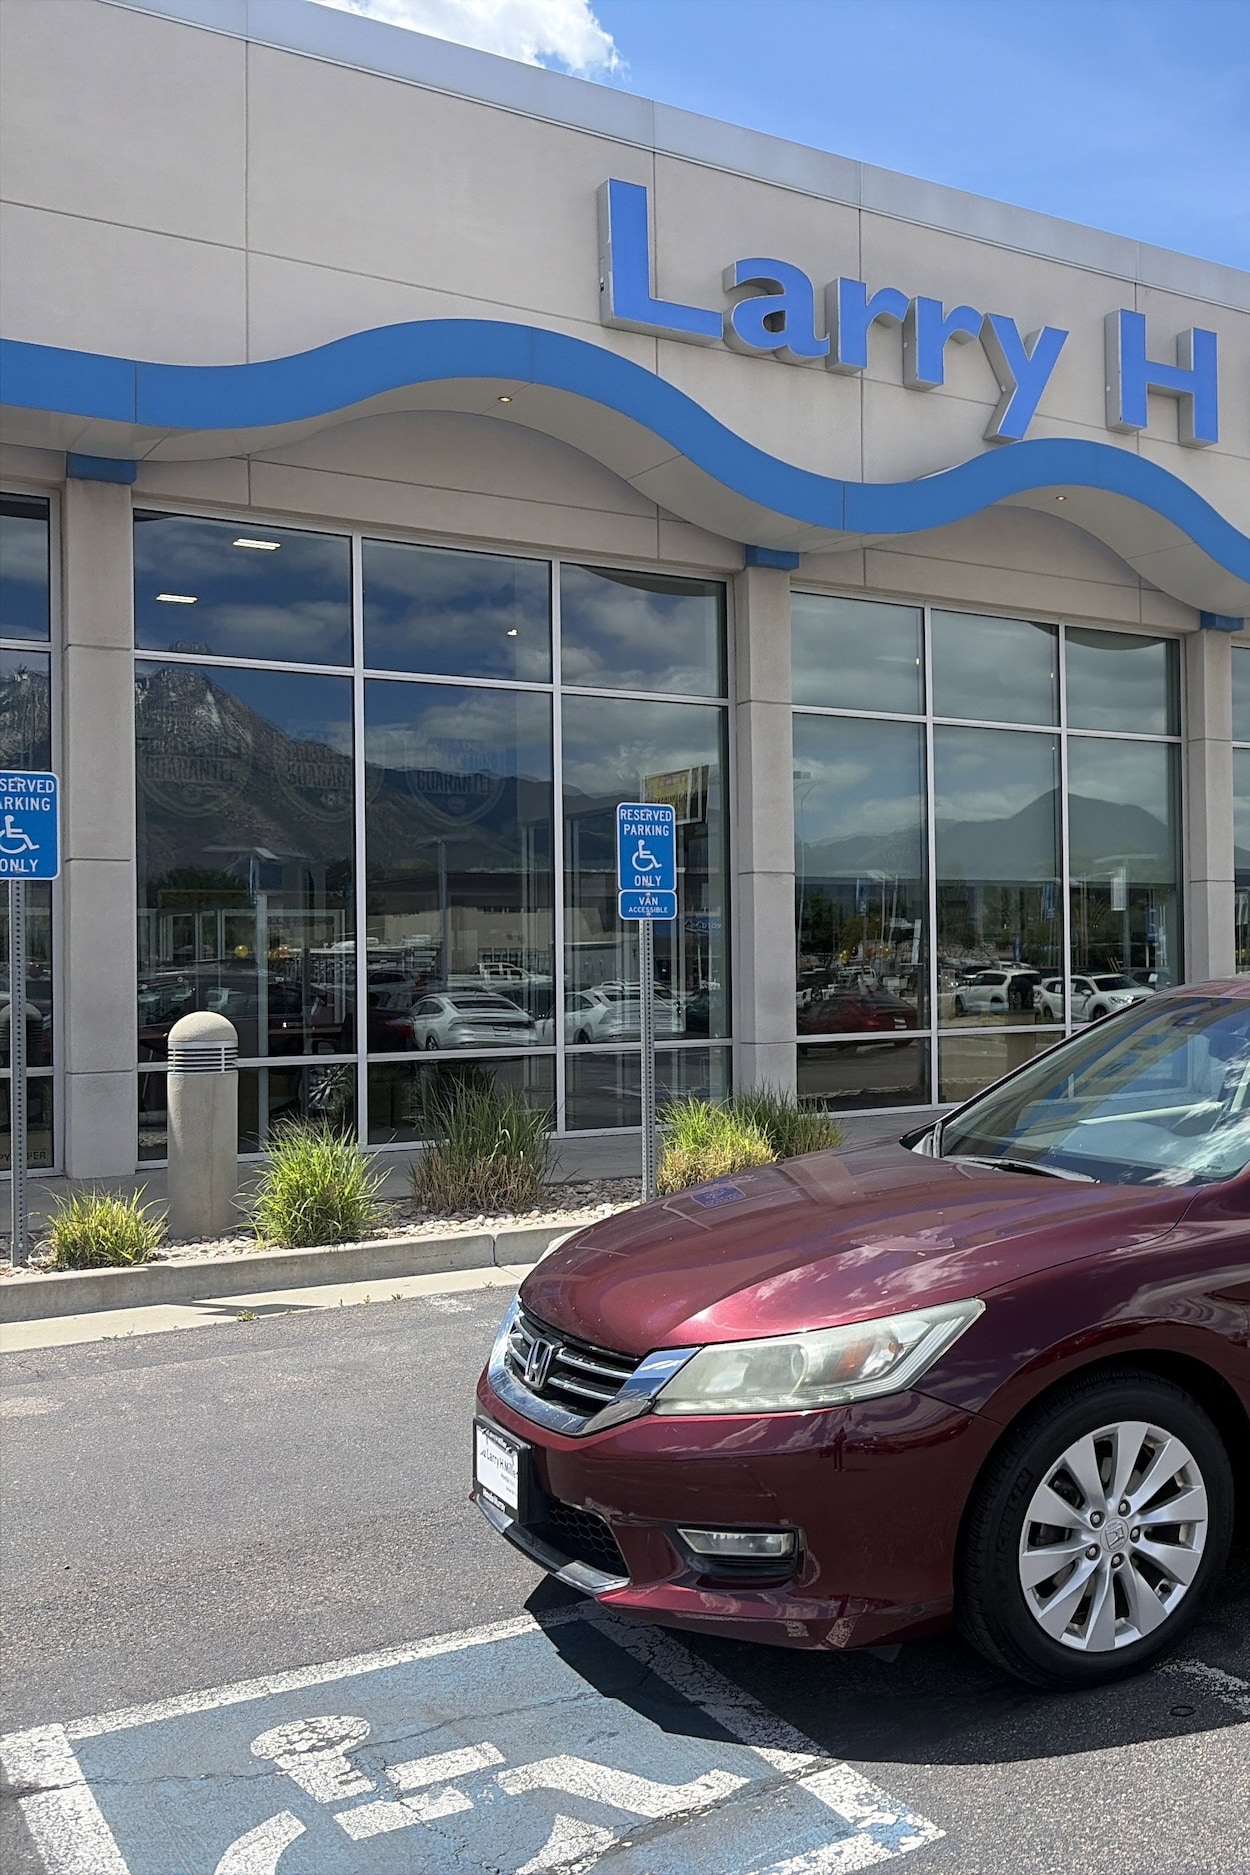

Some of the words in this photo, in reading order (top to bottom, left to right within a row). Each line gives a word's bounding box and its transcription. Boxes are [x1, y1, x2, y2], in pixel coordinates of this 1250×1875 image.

[604, 177, 1069, 443] Larry
[1106, 308, 1218, 447] H
[0, 796, 51, 812] RKING
[620, 809, 672, 822] RESERVED
[624, 824, 670, 837] PARKING
[634, 874, 662, 887] ONLY
[638, 896, 659, 906] VAN
[628, 906, 668, 914] ACCESSIBLE
